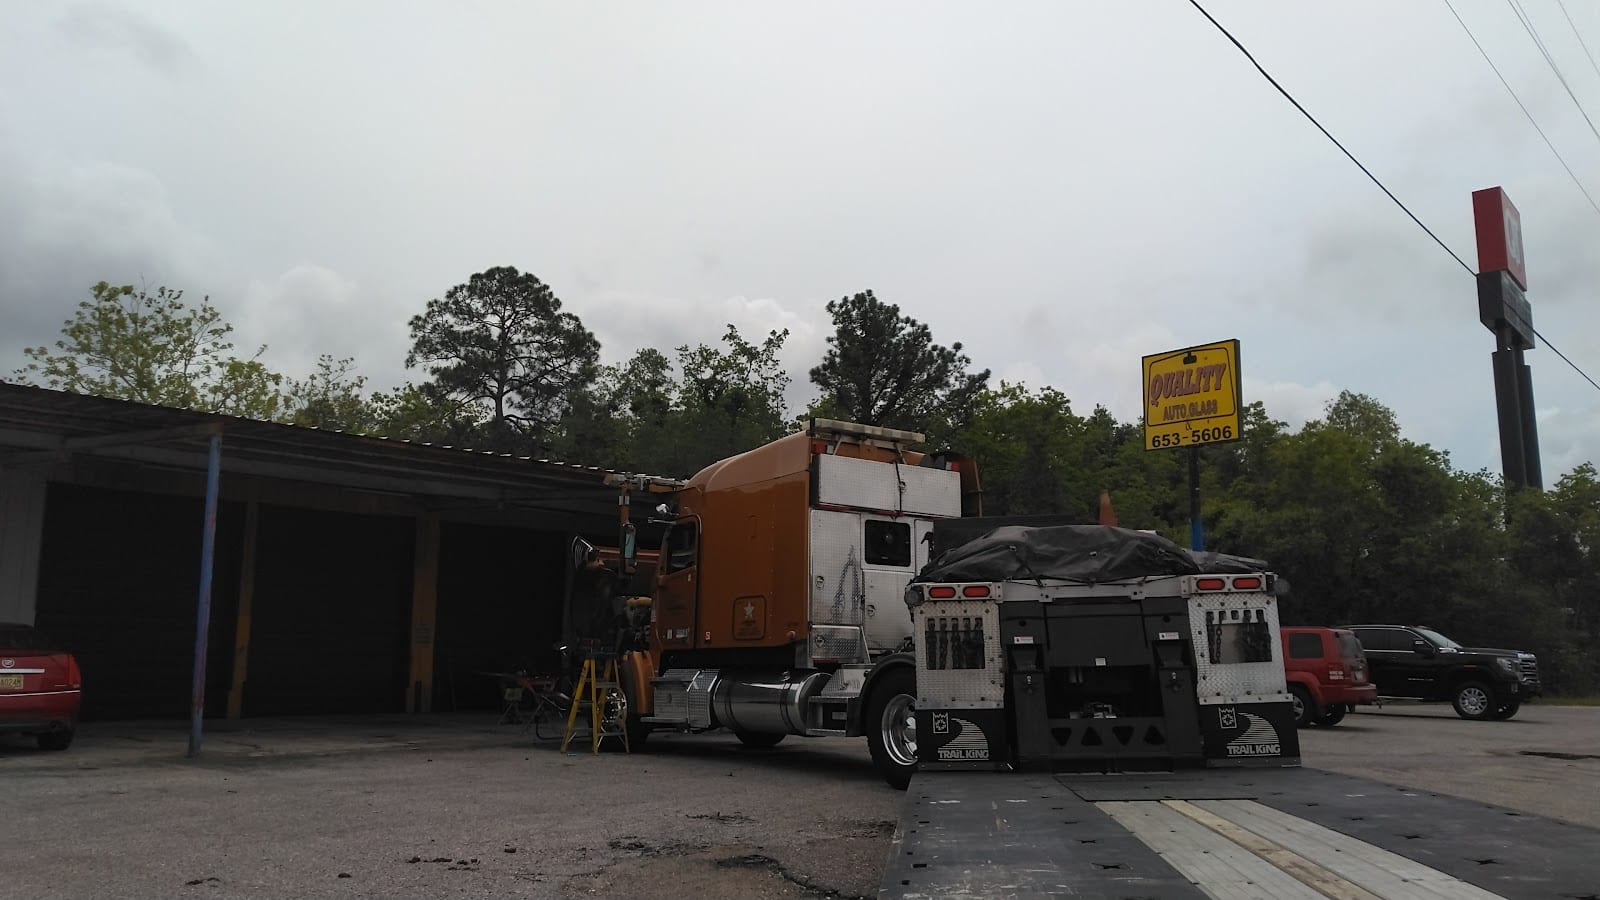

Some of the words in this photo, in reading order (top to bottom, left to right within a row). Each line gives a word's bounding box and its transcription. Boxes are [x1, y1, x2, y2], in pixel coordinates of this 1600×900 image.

[1151, 363, 1227, 407] QUALITY
[1163, 404, 1187, 421] AUTO
[1189, 399, 1218, 417] GLASS
[1152, 426, 1232, 448] 653-5606
